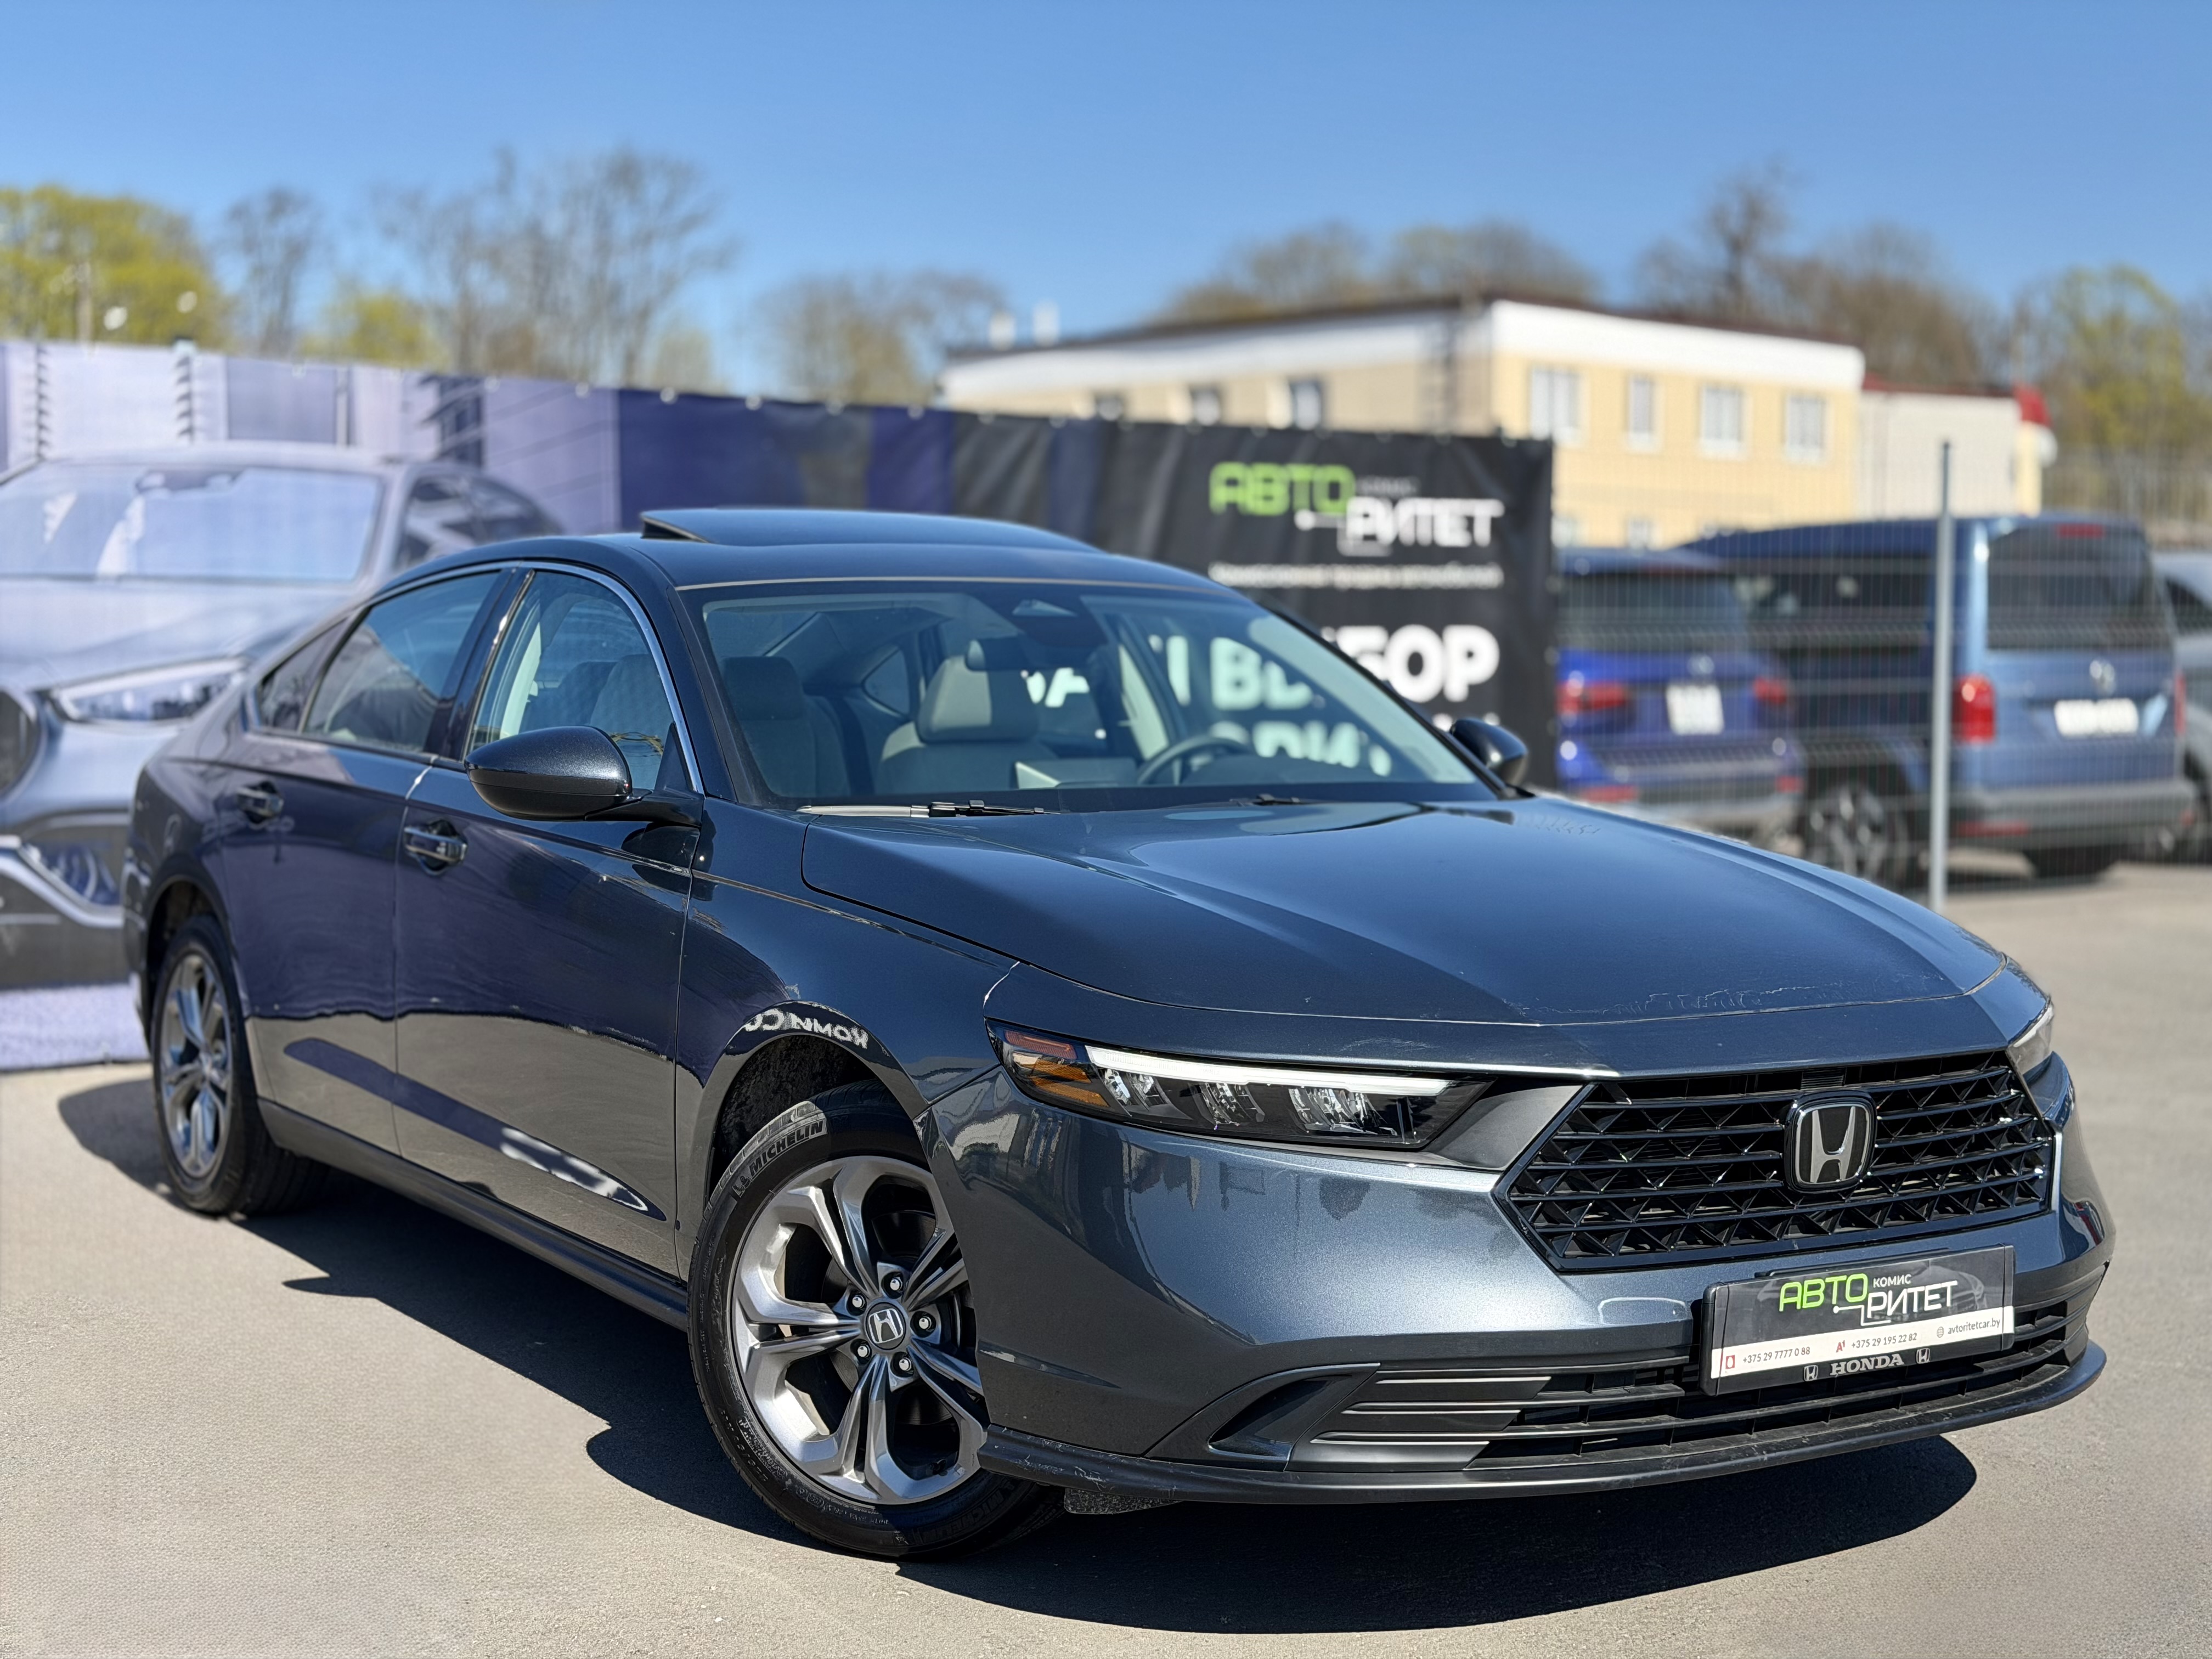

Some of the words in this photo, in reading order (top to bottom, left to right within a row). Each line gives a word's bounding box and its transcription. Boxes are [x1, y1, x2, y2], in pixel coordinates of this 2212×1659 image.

[1210, 462, 1355, 516] АВТО
[749, 1121, 823, 1177] MICHELIN
[1873, 1274, 1912, 1288] КОМИС
[1779, 1273, 1868, 1312] АВТО
[1867, 1280, 1958, 1318] РИТЕТ
[1948, 1318, 2001, 1335] avtoritetcar.by
[1851, 1339, 1870, 1348] +375
[1872, 1338, 1881, 1346] 29
[1883, 1335, 1897, 1345] 195
[1898, 1334, 1908, 1343] 22
[1908, 1333, 1917, 1342] 82
[1742, 1353, 1762, 1363] +375
[1763, 1352, 1772, 1361] 29
[1774, 1349, 1793, 1359] 7777
[1795, 1348, 1799, 1357] 0
[1801, 1346, 1810, 1355] 88
[1830, 1353, 1904, 1375] HONDA
